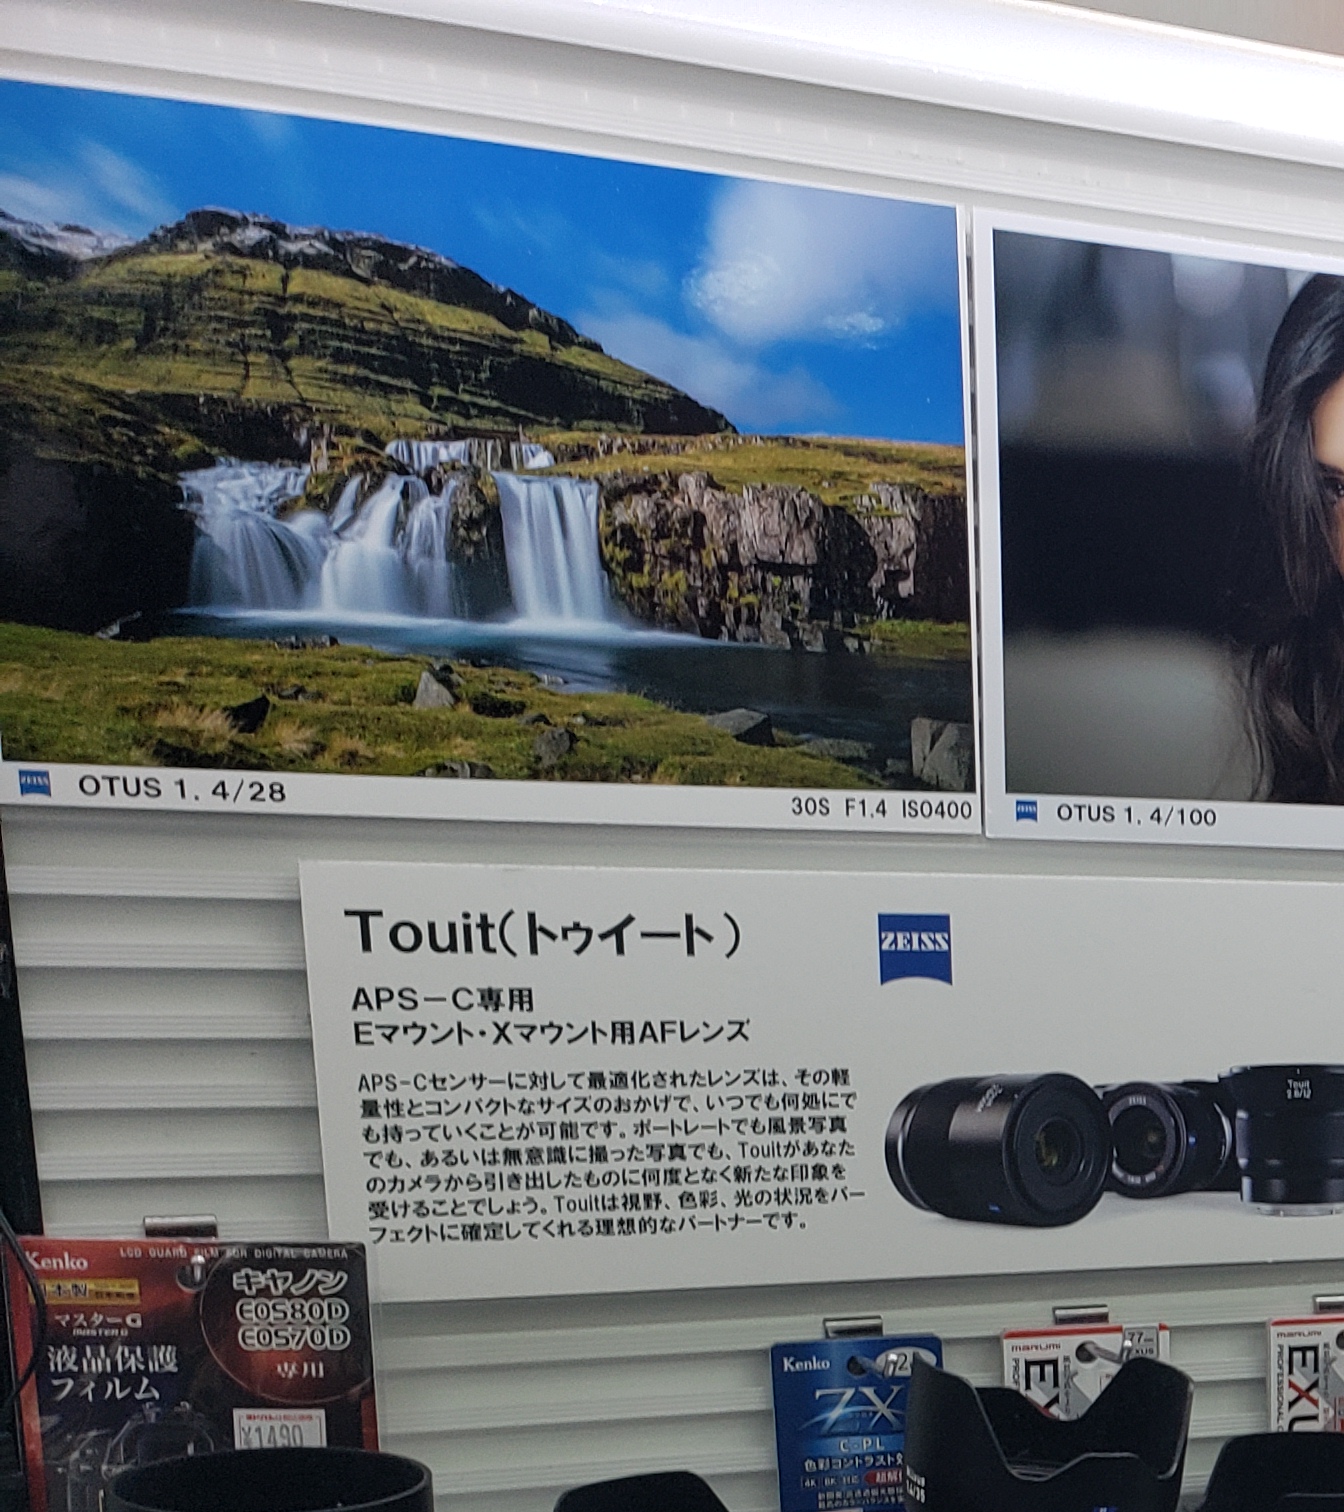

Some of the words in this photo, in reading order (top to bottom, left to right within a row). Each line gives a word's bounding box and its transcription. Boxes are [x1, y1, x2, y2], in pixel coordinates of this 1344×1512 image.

[78, 774, 162, 799] OTUS
[791, 797, 830, 818] 30S
[845, 798, 888, 820] F1.4
[902, 800, 973, 821] ISO400
[1057, 805, 1115, 826] OTUS
[880, 931, 951, 952] ZEISS
[26, 1252, 88, 1271] Kenko
[236, 1299, 349, 1324] EOS80D
[238, 1326, 350, 1351] EOS70D
[49, 1345, 179, 1373] 液晶保護
[783, 1356, 831, 1372] Kenko
[52, 1377, 160, 1401] フィルム
